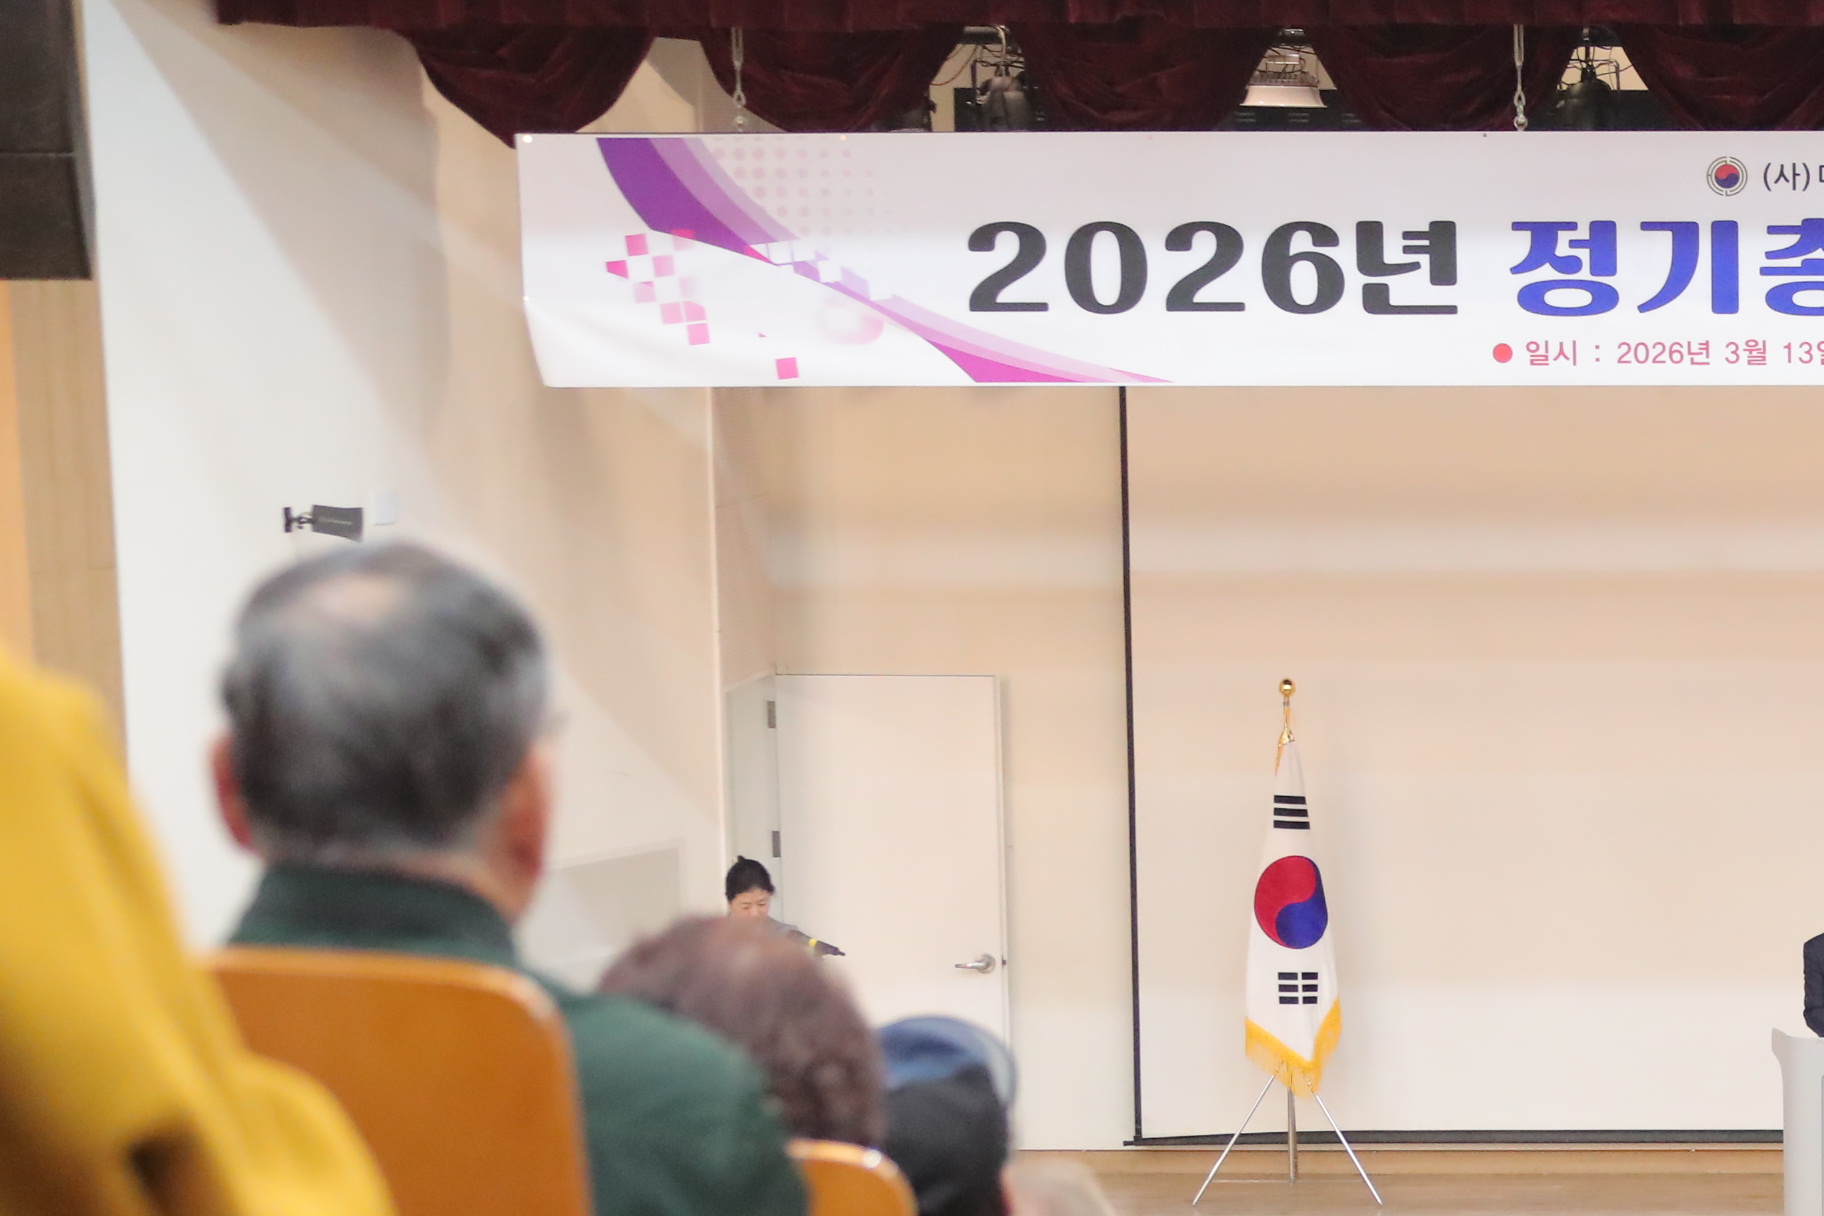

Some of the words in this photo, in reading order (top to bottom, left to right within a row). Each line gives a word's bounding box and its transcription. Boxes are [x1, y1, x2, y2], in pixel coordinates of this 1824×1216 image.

[967, 219, 1459, 316] 2026년
[1525, 339, 1577, 366] 일시
[1616, 339, 1711, 366] 2026년
[1724, 338, 1767, 366] 3월
